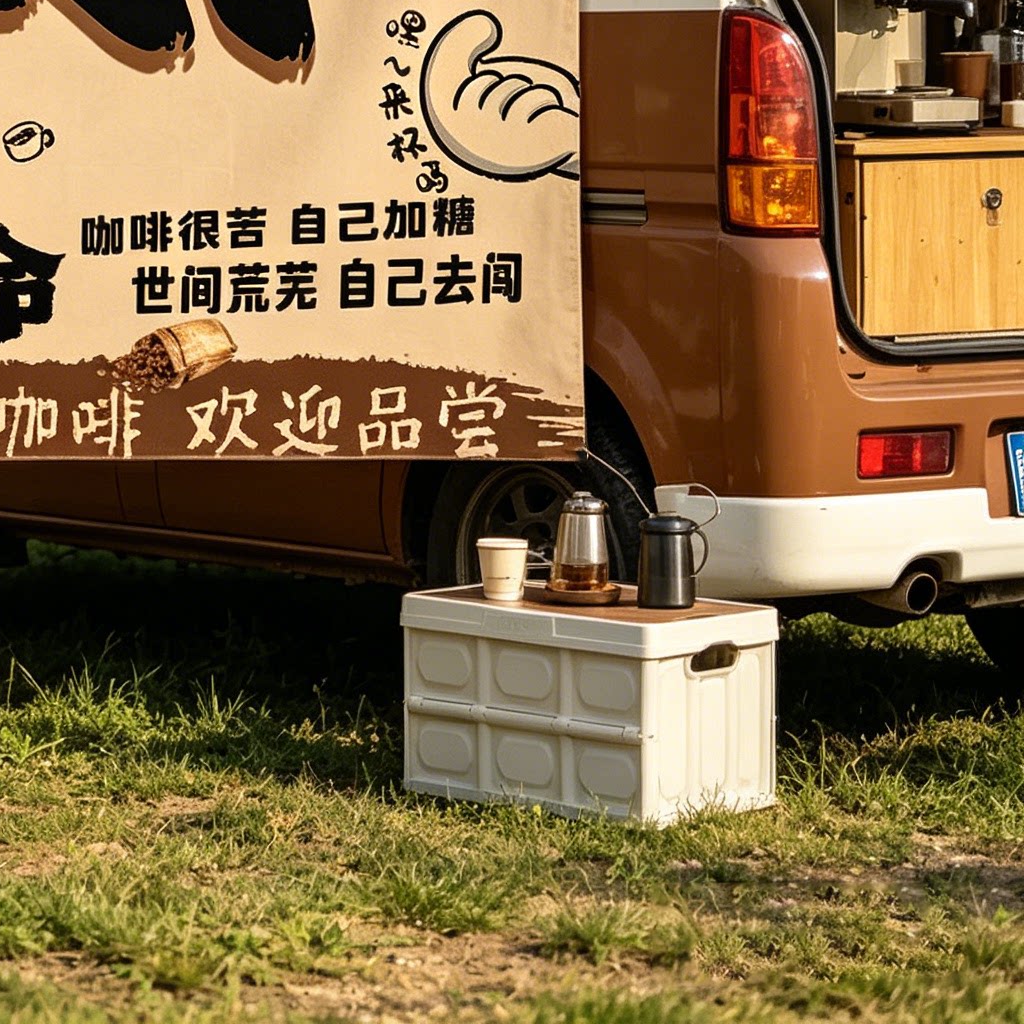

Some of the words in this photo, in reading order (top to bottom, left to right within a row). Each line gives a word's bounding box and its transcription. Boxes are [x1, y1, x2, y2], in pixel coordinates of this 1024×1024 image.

[80, 206, 268, 256] 咖啡很苦
[291, 194, 475, 245] 自己加糖
[131, 261, 318, 315] 世间荒芜
[339, 252, 523, 310] 自己去闯
[186, 381, 507, 458] 欢迎品尝
